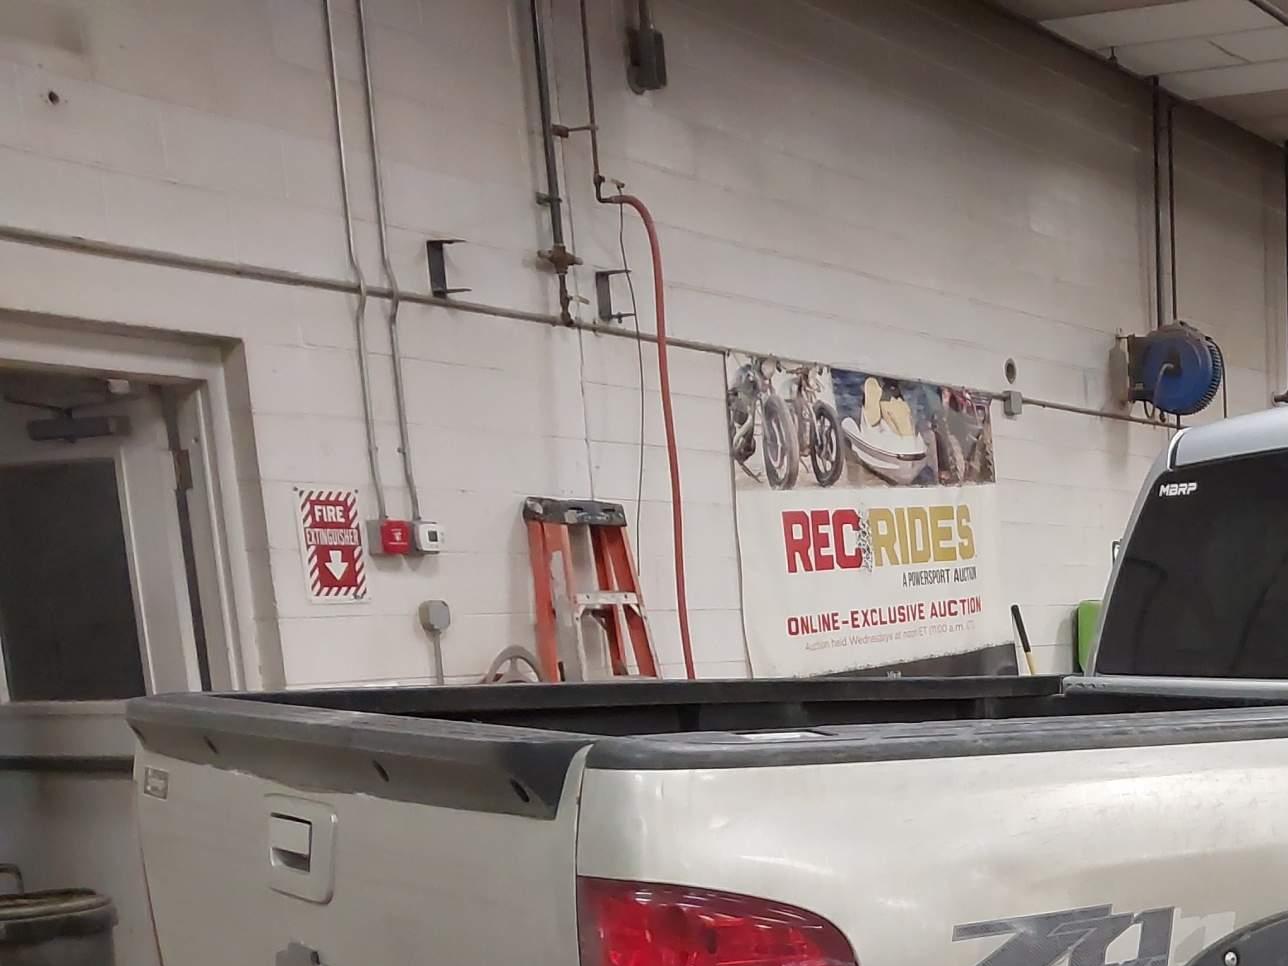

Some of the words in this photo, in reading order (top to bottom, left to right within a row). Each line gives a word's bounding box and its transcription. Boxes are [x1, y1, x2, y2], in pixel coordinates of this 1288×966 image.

[1159, 482, 1198, 497] MBRP
[314, 505, 346, 523] FIRE
[306, 528, 359, 546] EXTINGUISHER
[782, 509, 863, 573] REC
[868, 504, 977, 567] RIDES
[902, 571, 908, 588] A
[908, 569, 951, 587] POWERSPORT
[954, 566, 977, 583] AUCTION
[787, 603, 926, 636] ONLINE-EXCLUSIVE
[930, 597, 982, 619] AUCTION
